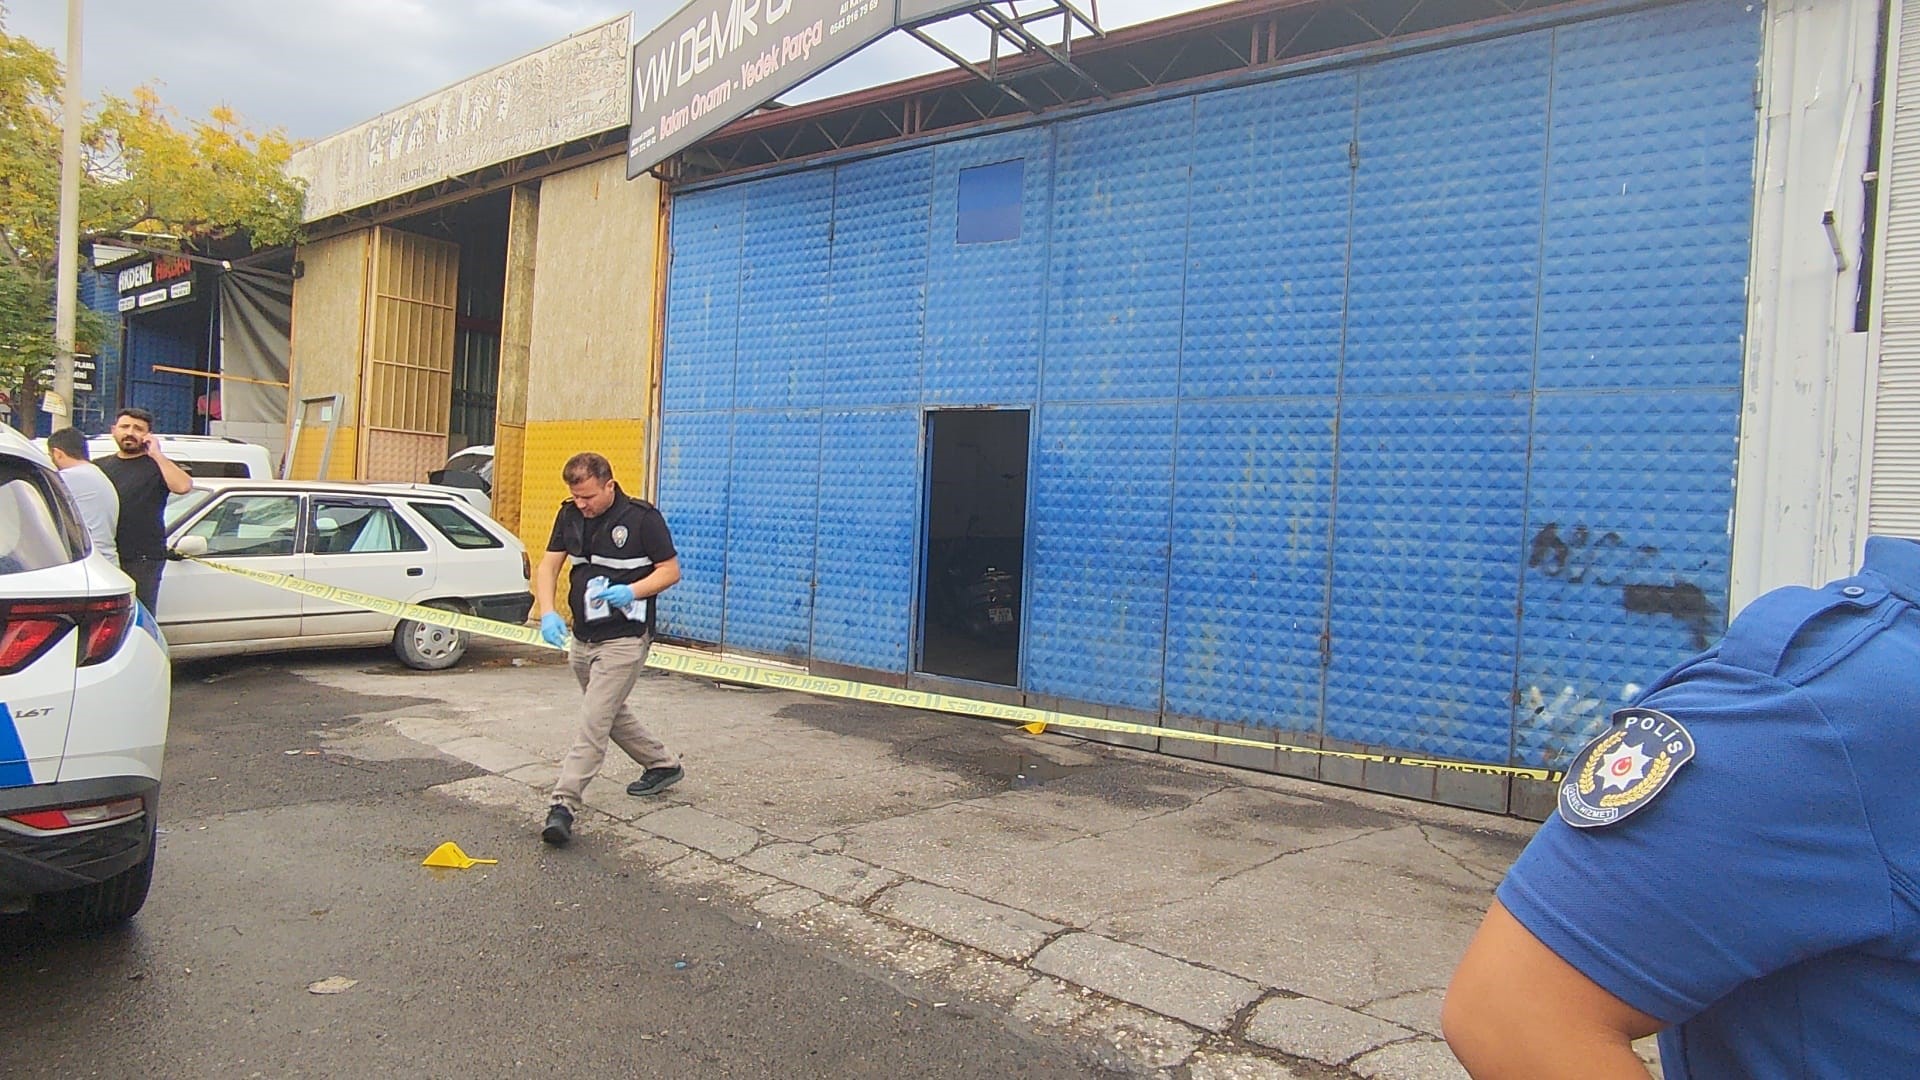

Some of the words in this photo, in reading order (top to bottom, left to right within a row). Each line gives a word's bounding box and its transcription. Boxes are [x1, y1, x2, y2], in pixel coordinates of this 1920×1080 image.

[741, 44, 780, 90] Yedek
[782, 19, 824, 66] Parça
[1625, 716, 1684, 755] POLİS
